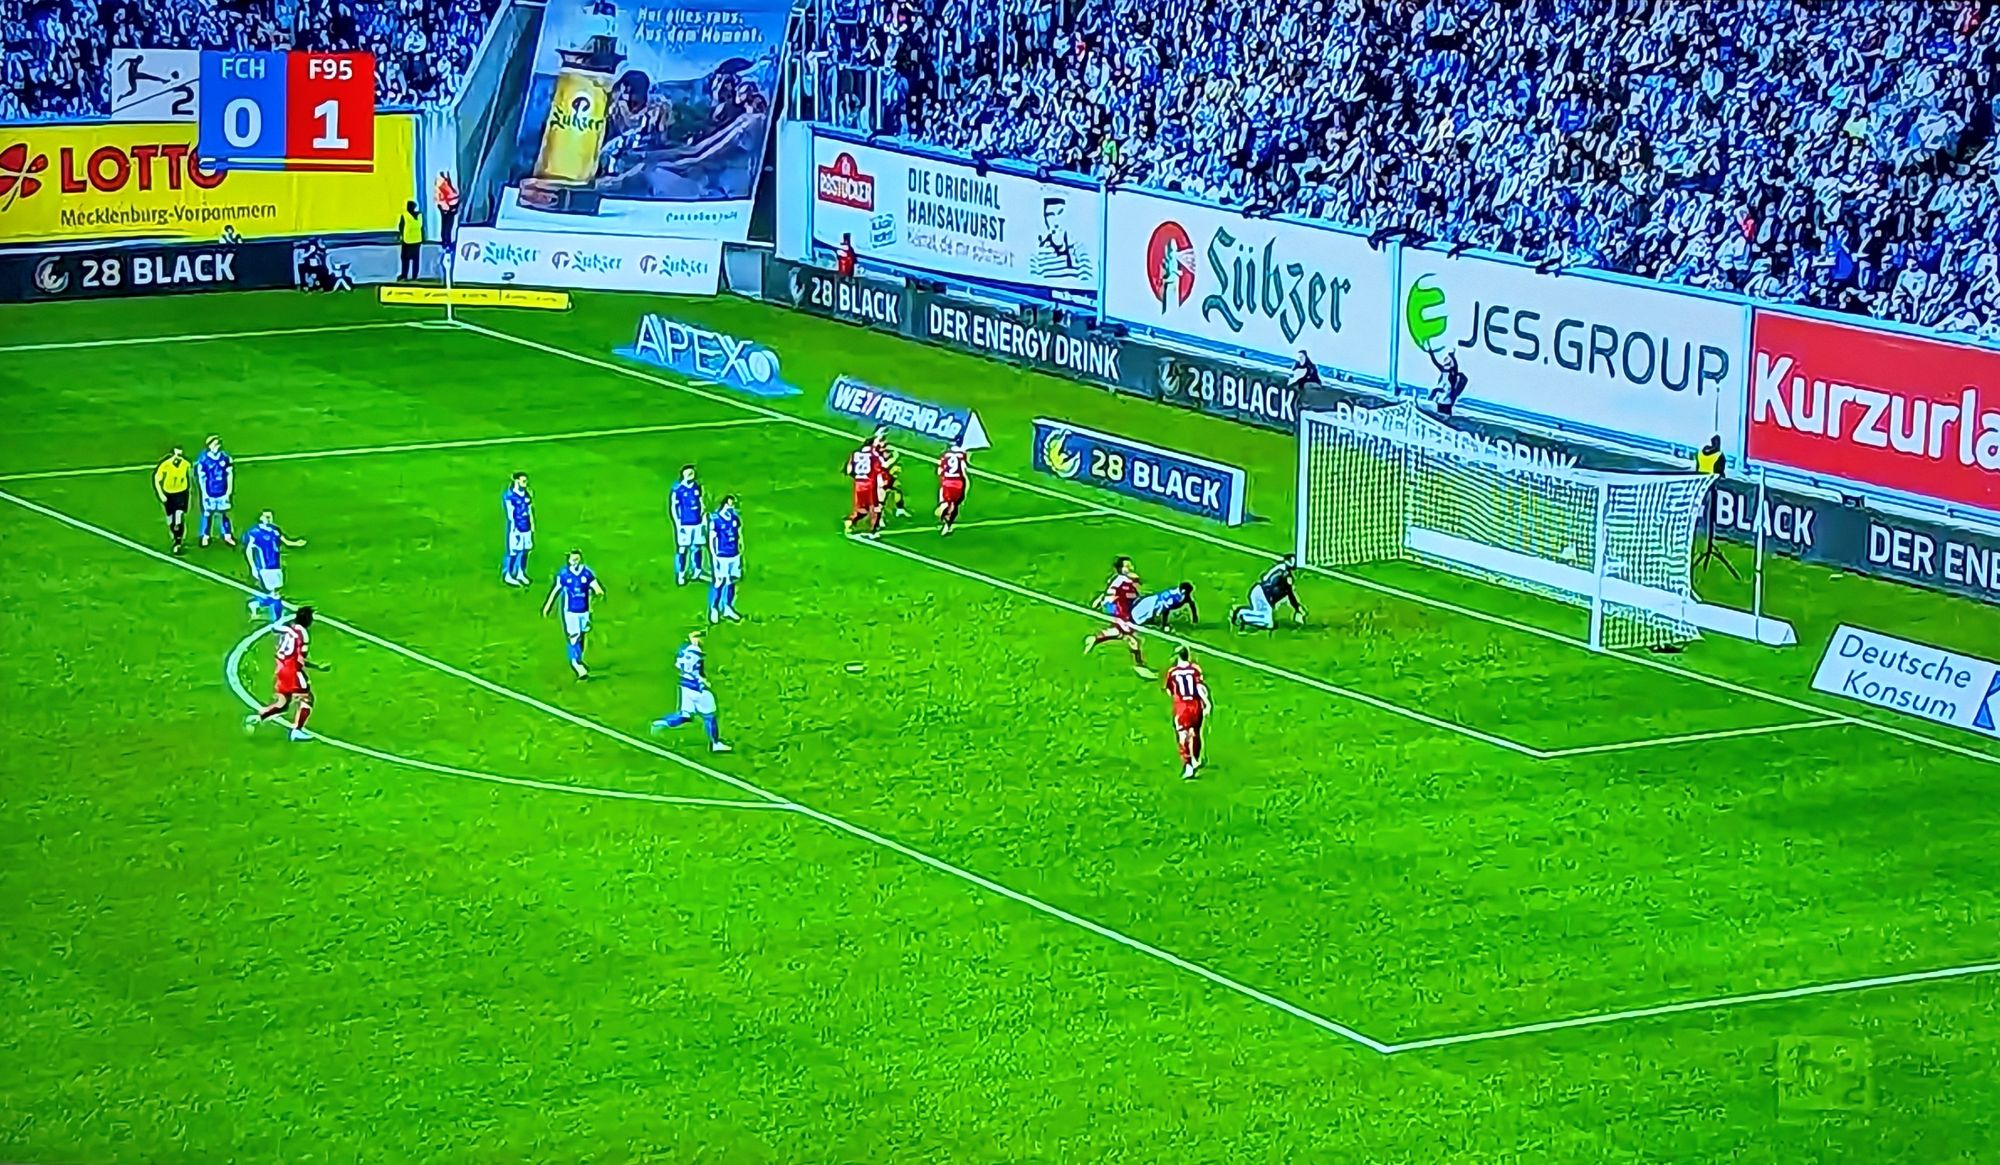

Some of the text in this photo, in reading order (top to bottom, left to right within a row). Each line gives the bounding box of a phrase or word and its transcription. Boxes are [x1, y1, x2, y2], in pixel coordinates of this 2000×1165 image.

[60, 144, 229, 190] LOTTO
[908, 167, 1001, 210] DIE ORIGINAL
[60, 204, 277, 227] Mecklenburg-Vorpommern
[907, 198, 1006, 243] HANSAWURST
[81, 253, 235, 287] 28 BLACK
[1202, 226, 1351, 344] Lübzer
[811, 276, 898, 325] 28 BLACK
[930, 303, 1120, 381] DER ENERGY DRINK
[1458, 300, 1729, 396] JES.GROUP
[1188, 366, 1296, 422] 28 BLACK
[1753, 351, 2000, 472] Kurzurla
[1091, 449, 1221, 510] 28 BLACK
[1715, 488, 1813, 547] BLACK
[1869, 524, 1935, 576] DER
[1175, 674, 1194, 697] 11
[1839, 634, 1971, 689] Deutsche
[1842, 669, 1957, 720] Konsum
